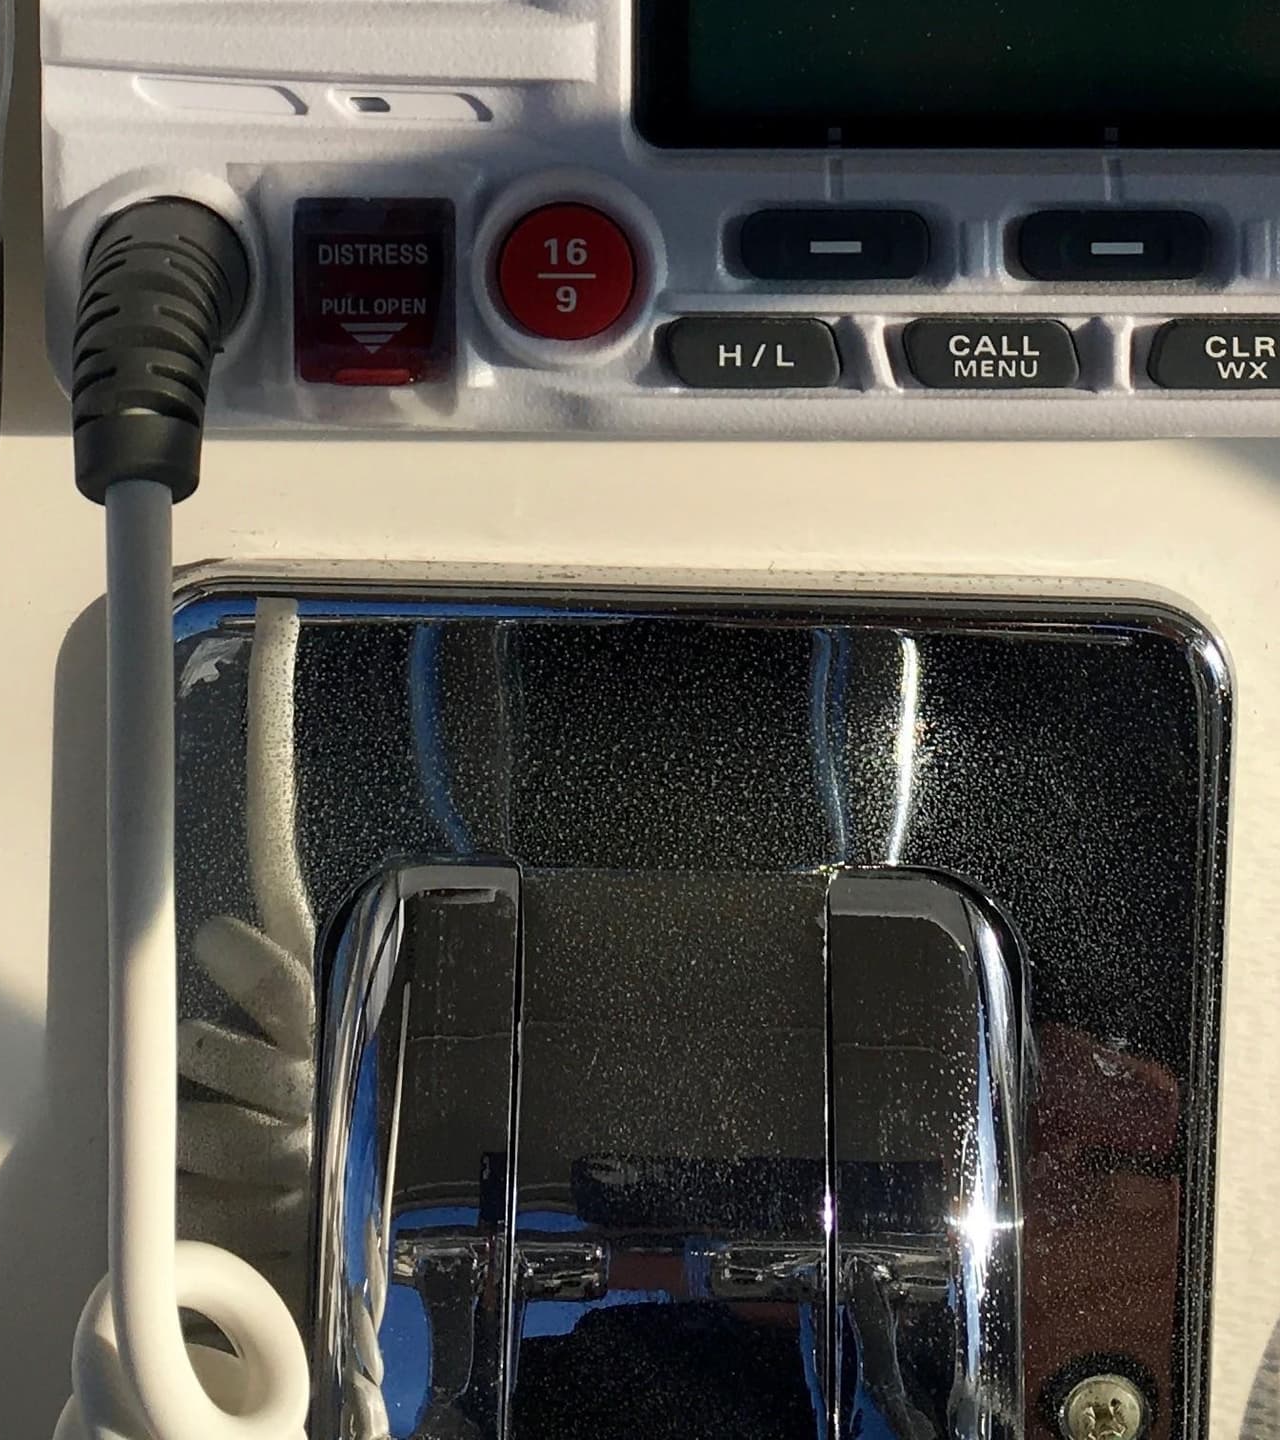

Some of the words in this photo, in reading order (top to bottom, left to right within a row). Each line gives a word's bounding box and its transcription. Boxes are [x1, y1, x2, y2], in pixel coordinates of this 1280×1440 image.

[318, 243, 429, 266] DISTRESS
[543, 237, 588, 266] 16
[321, 297, 370, 315] PULL
[373, 297, 427, 315] OPEN
[555, 286, 578, 313] 9
[948, 335, 1040, 358] CALL
[1204, 336, 1276, 359] CLR
[954, 360, 1039, 378] MENU
[1216, 361, 1269, 380] WX
